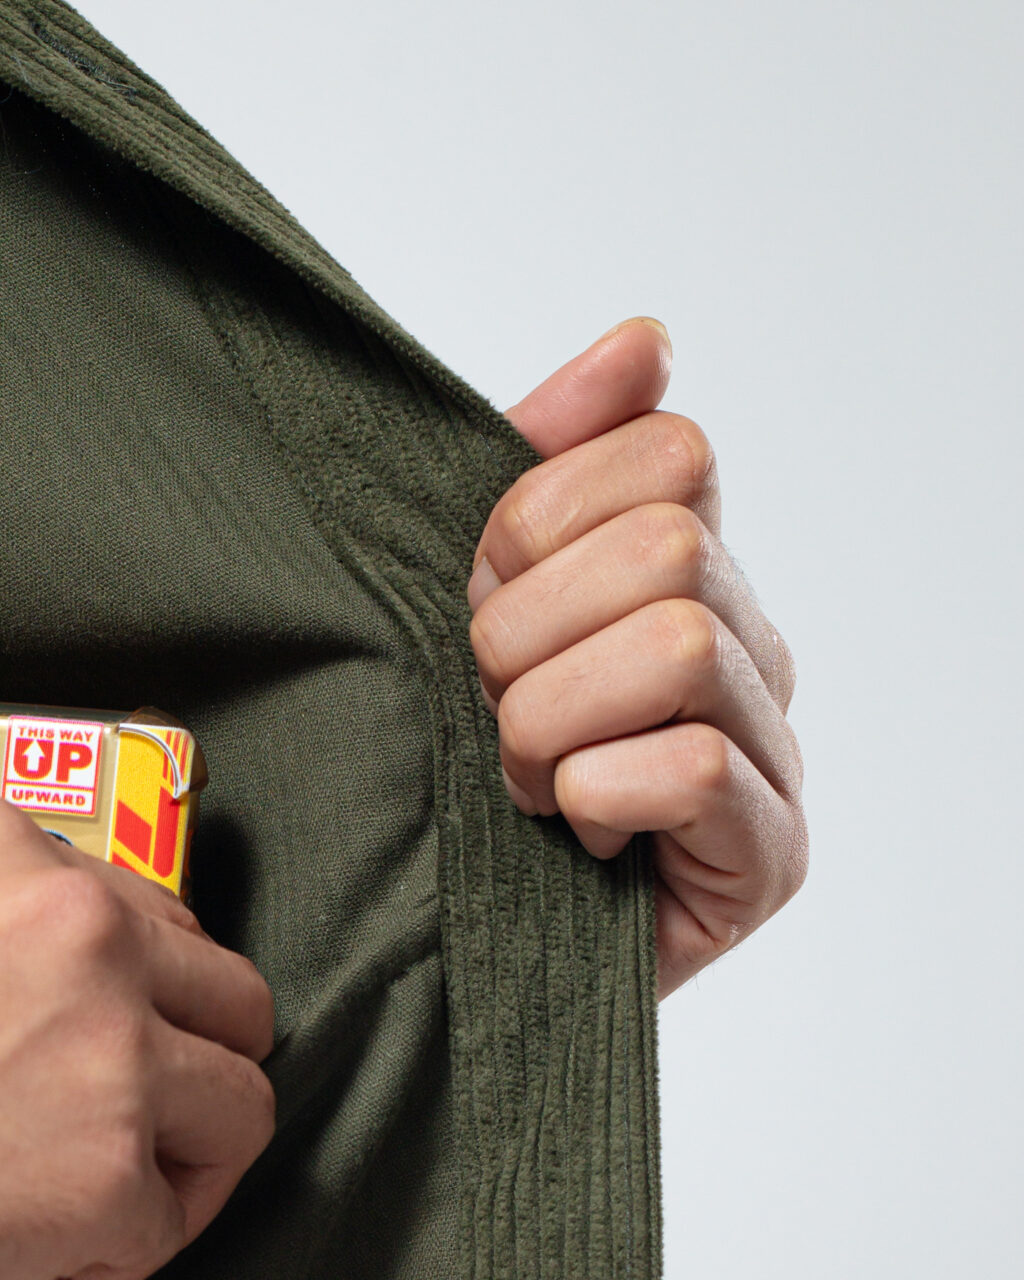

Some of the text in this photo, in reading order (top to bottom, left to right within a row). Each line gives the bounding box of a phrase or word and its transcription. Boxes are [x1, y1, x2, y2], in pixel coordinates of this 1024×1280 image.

[18, 726, 94, 742] THIS WAY
[13, 738, 93, 783] UP
[11, 789, 86, 807] UPWARD
